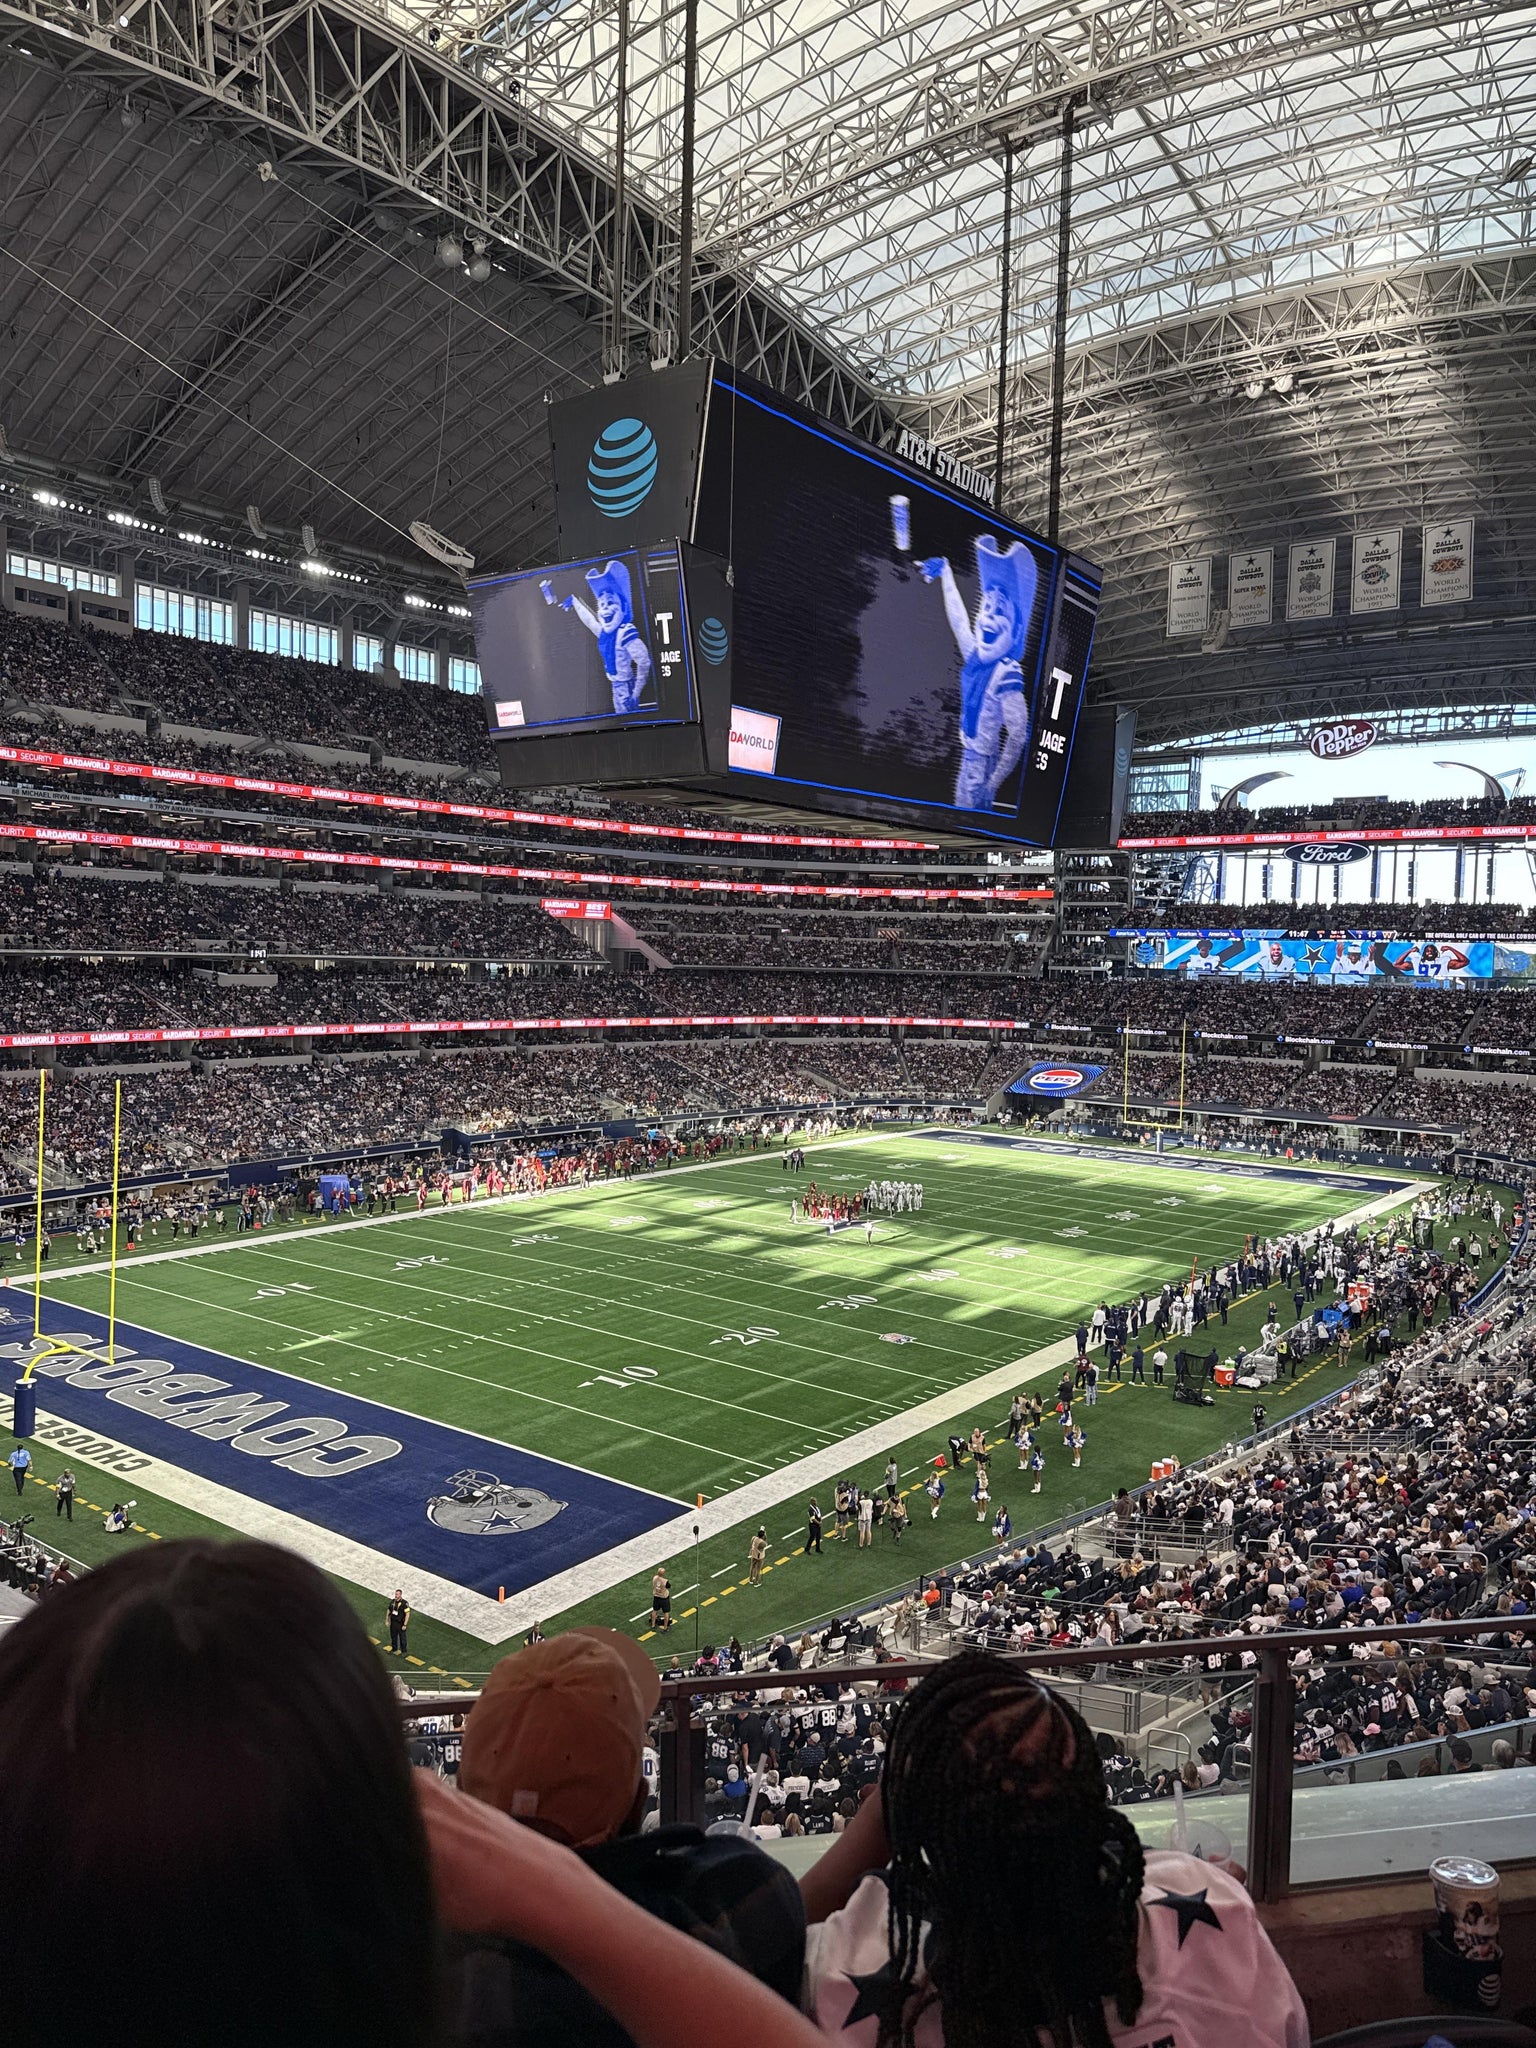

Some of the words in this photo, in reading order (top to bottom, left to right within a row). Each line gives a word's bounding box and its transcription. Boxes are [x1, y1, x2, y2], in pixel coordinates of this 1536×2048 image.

[896, 430, 936, 470] AT&T
[936, 451, 997, 509] STADIUM
[1433, 545, 1464, 554] COWBOYS
[1436, 539, 1461, 548] DALLAS
[1362, 555, 1391, 563] COWBOYS
[1365, 549, 1389, 557] DALLAS
[1434, 578, 1460, 586] WORLD
[1335, 722, 1357, 741] Dr
[1316, 727, 1373, 757] Pepper
[20, 751, 53, 763] SECURITY
[63, 757, 110, 771] GARDAWORLD
[113, 764, 143, 774] SECURITY
[152, 768, 196, 781] GARDAWORLD
[198, 775, 226, 785] SECURITY
[234, 779, 275, 791] GARDAWORLD
[278, 785, 303, 795] SECURITY
[22, 790, 51, 798] MICHAEL
[311, 788, 349, 800] GARDAWORLD
[351, 794, 376, 804] SECURITY
[36, 829, 88, 842] GARDAWORLD
[91, 834, 123, 845] SECURITY
[1326, 831, 1365, 840] GARDAWORLD
[1402, 829, 1443, 837] GARDAWORLD
[1482, 827, 1527, 835] GARDAWORLD
[1254, 834, 1291, 842] GARDAWORLD
[132, 838, 180, 850] GARDAWORLD
[183, 842, 212, 852] SECURITY
[221, 844, 265, 856] GARDAWORLD
[267, 849, 296, 859] SECURITY
[303, 851, 344, 863] GARDAWORLD
[346, 855, 374, 865] SECURITY
[1300, 843, 1353, 862] Ford
[1288, 930, 1309, 938] 11:47
[1418, 964, 1442, 977] 97
[12, 1035, 55, 1045] GARDAWORLD
[58, 1035, 85, 1043] SECURITY
[90, 1033, 130, 1042] GARDAWORLD
[132, 1032, 157, 1041] SECURITY
[1201, 1032, 1248, 1040] Blockchain.com
[1285, 1036, 1335, 1045] Blockchain.com
[1374, 1041, 1428, 1050] Blockchain.com
[1473, 1046, 1530, 1056] Blockchain.com
[1036, 1074, 1078, 1084] PEPSI
[916, 1268, 961, 1283] 40
[257, 1281, 317, 1298] 10
[835, 1293, 878, 1311] 30
[719, 1325, 781, 1347] 20
[593, 1365, 659, 1390] 10
[0, 1333, 403, 1477] COWBOYS
[862, 1703, 872, 1716] 9
[1380, 1693, 1397, 1713] 88
[802, 1713, 814, 1730] 88
[822, 1709, 836, 1726] 88
